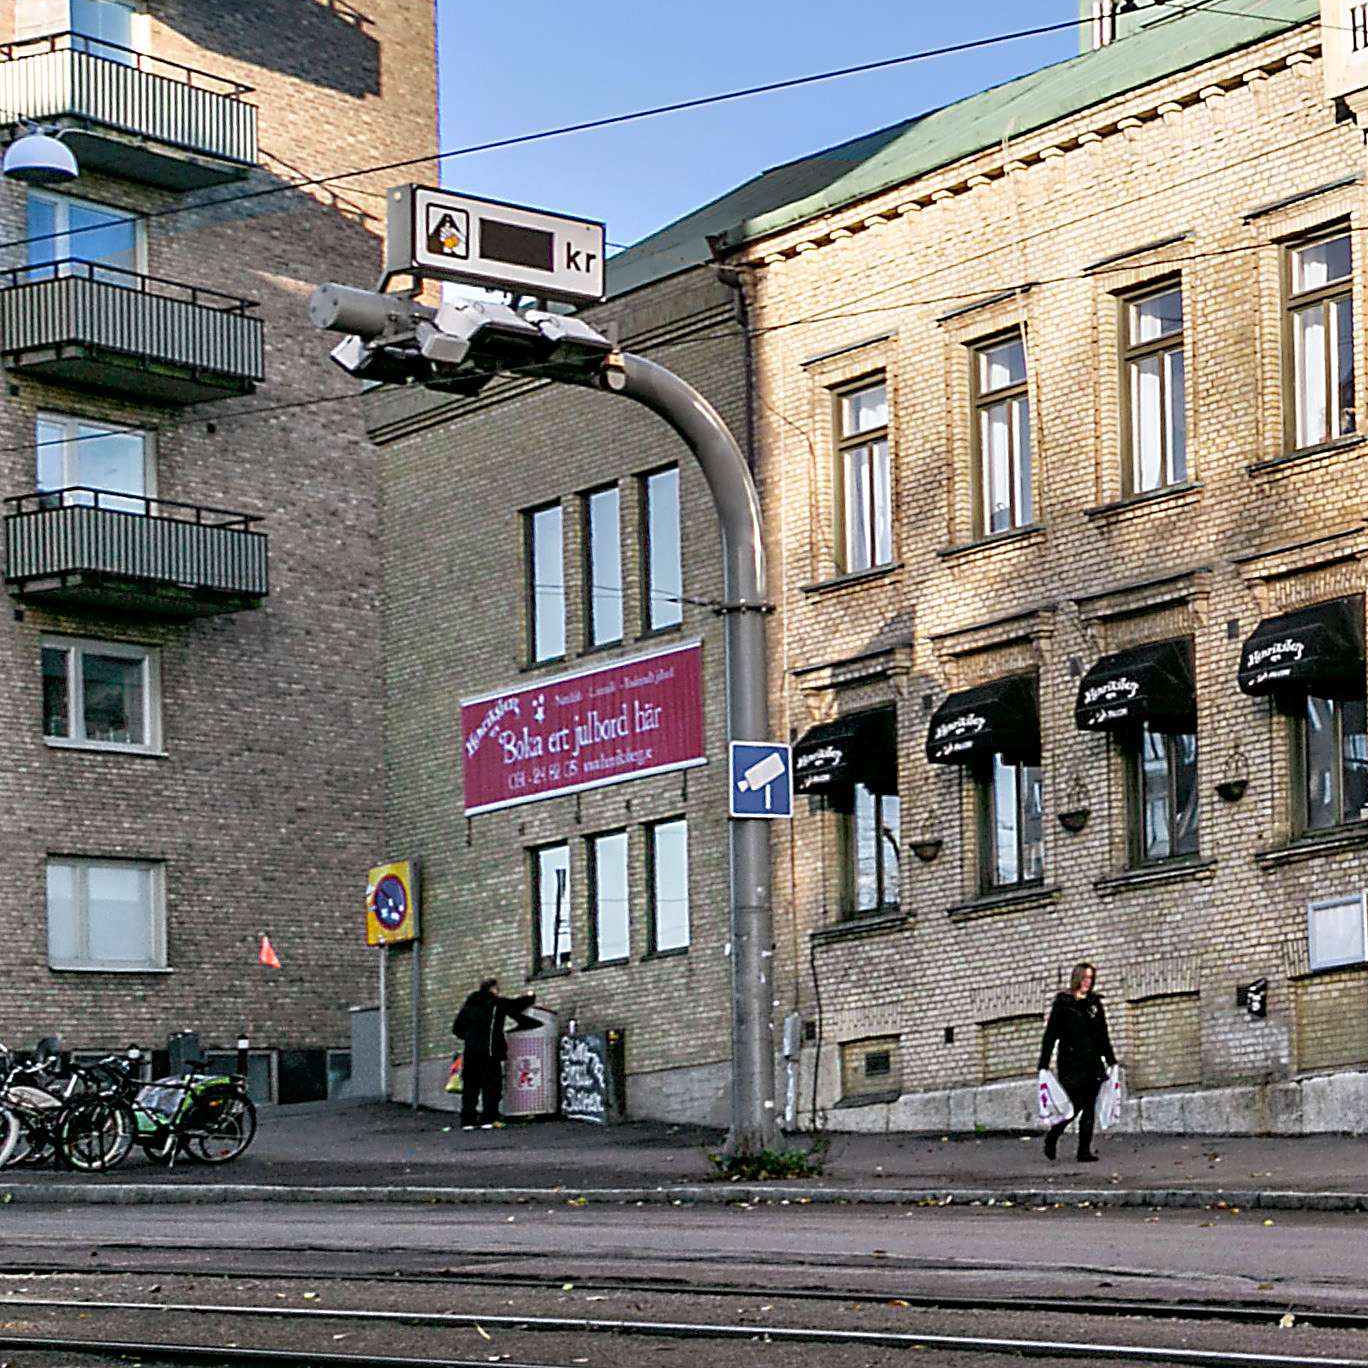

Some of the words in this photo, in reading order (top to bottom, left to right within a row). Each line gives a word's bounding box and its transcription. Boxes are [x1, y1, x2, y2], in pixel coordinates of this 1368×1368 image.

[565, 241, 597, 274] kr
[498, 726, 544, 764] Boka
[548, 728, 570, 753] ert
[572, 702, 629, 756] julbord
[634, 699, 662, 733] här
